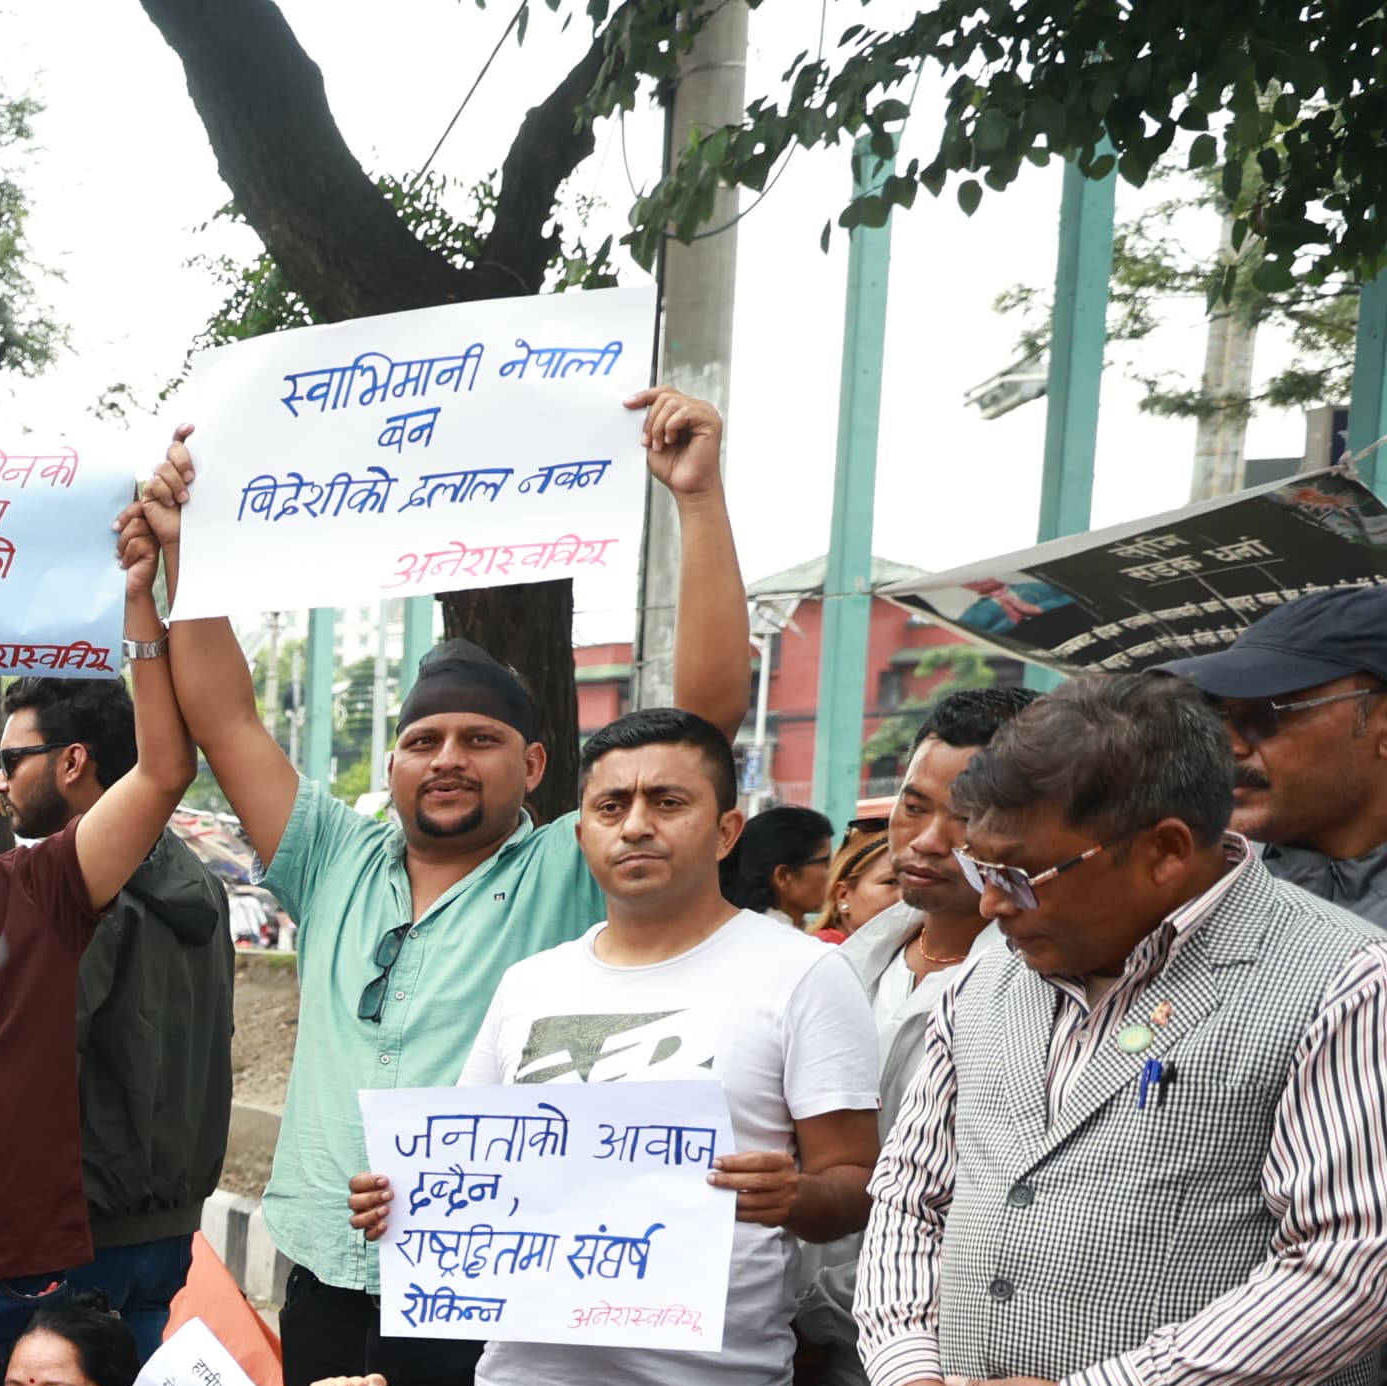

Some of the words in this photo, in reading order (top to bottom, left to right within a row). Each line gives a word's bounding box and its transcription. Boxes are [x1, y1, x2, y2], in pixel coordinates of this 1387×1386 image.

[280, 343, 485, 418] स्वाभिमानी
[498, 338, 624, 380] नेपाली
[377, 406, 441, 454] बन
[398, 466, 515, 514] दलाल
[395, 1102, 570, 1163] जनताको
[592, 1123, 718, 1170] आवाज
[567, 1222, 667, 1280] संघर्ष
